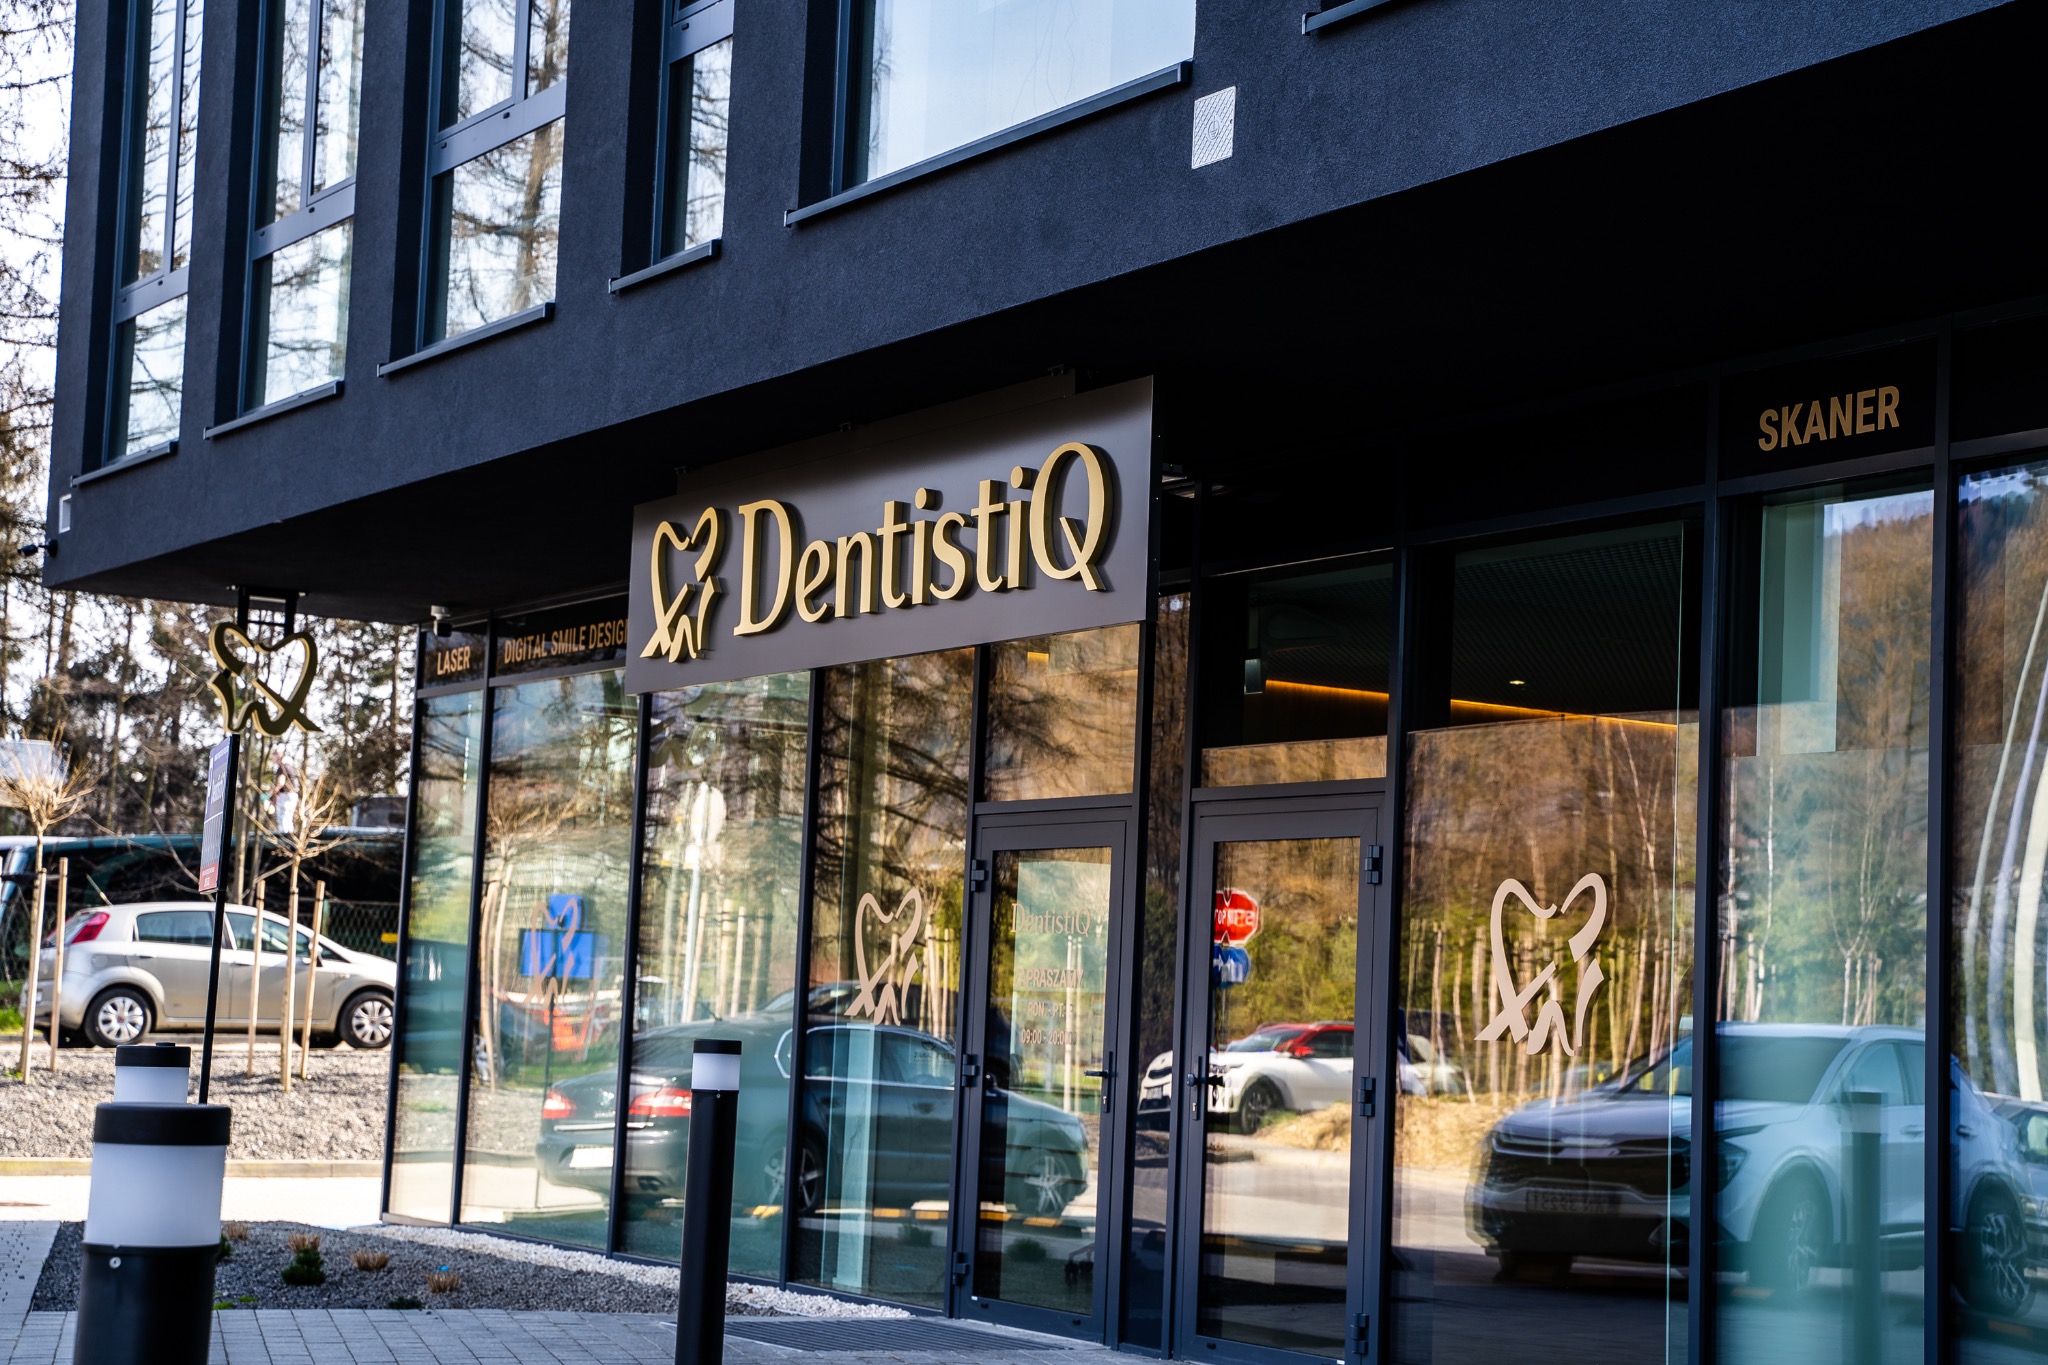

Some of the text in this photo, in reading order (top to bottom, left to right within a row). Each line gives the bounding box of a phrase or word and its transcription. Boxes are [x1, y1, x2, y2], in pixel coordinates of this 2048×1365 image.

[1758, 385, 1900, 451] SKANER
[733, 442, 1112, 636] DentistiQ
[437, 646, 471, 675] LASER
[504, 618, 628, 664] DIGITAL SMILE DESIG
[1010, 902, 1091, 938] DentistiQ
